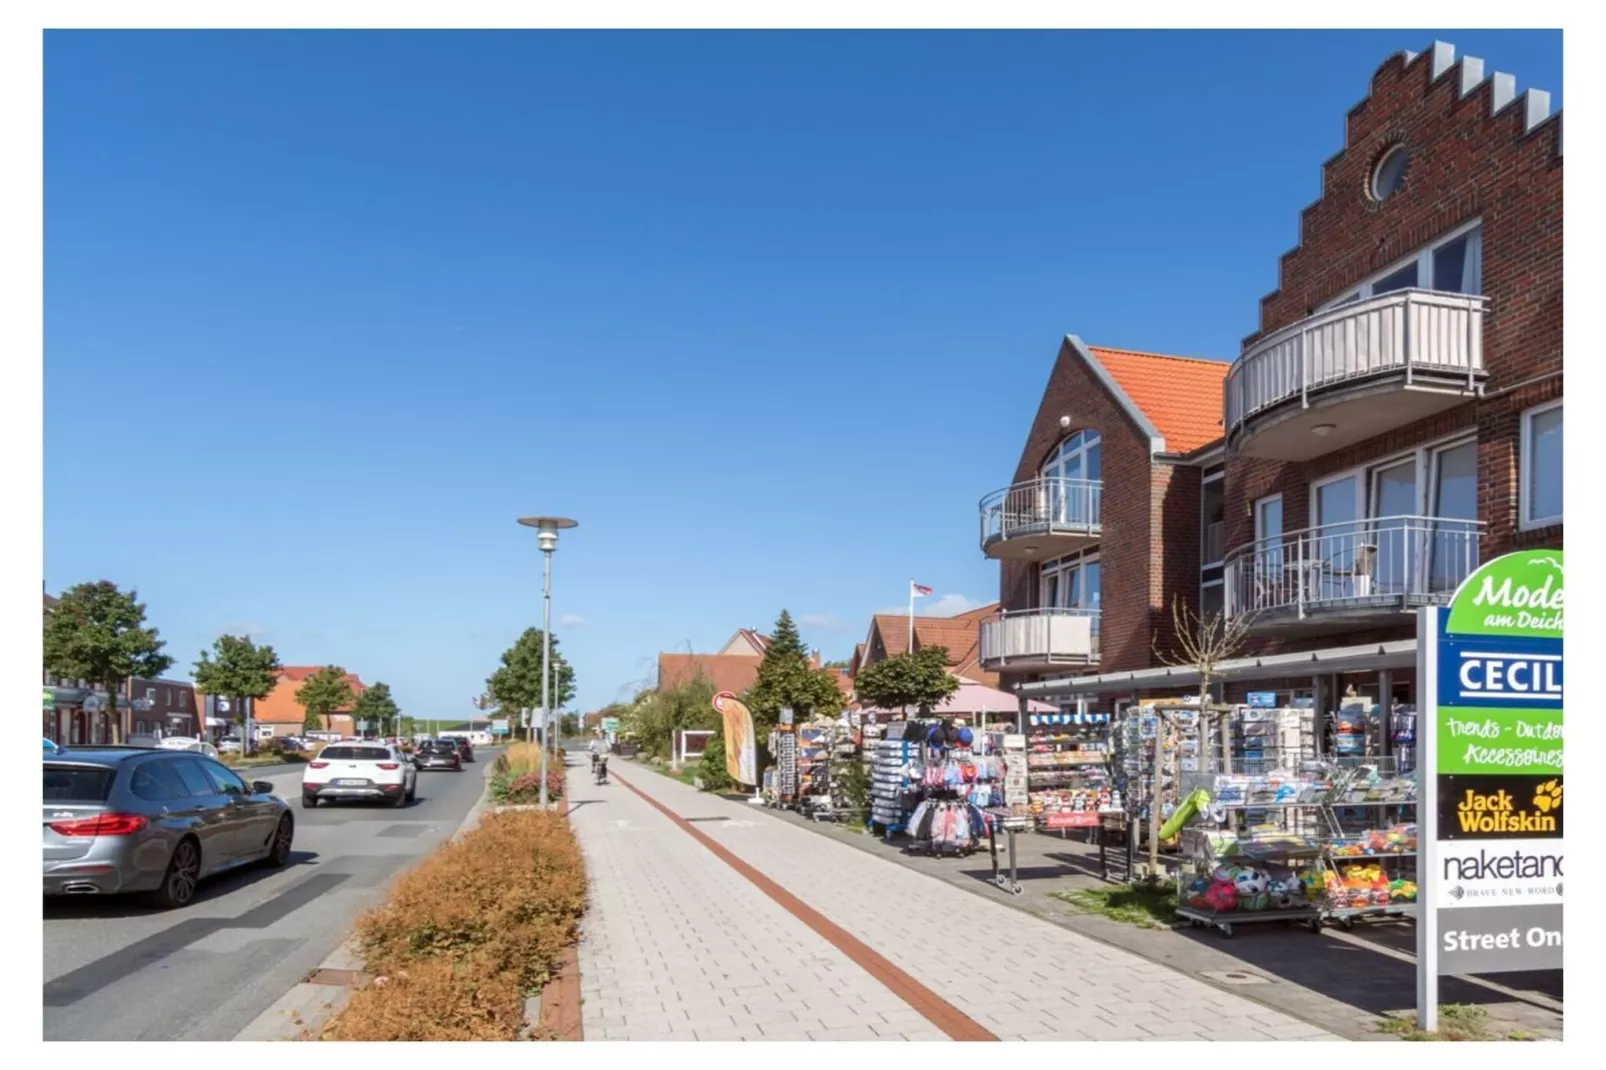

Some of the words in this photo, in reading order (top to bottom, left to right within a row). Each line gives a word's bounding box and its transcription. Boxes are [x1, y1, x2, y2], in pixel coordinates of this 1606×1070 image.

[1472, 574, 1563, 609] Mode
[1484, 614, 1515, 627] am
[1517, 610, 1563, 630] Deich
[1459, 659, 1562, 692] CECIL
[1458, 789, 1513, 811] Jack
[1457, 810, 1556, 832] Wolfskin
[1466, 888, 1498, 897] BRAVE
[1501, 887, 1522, 896] NEW
[1443, 928, 1520, 951] Street
[1526, 927, 1563, 947] On
